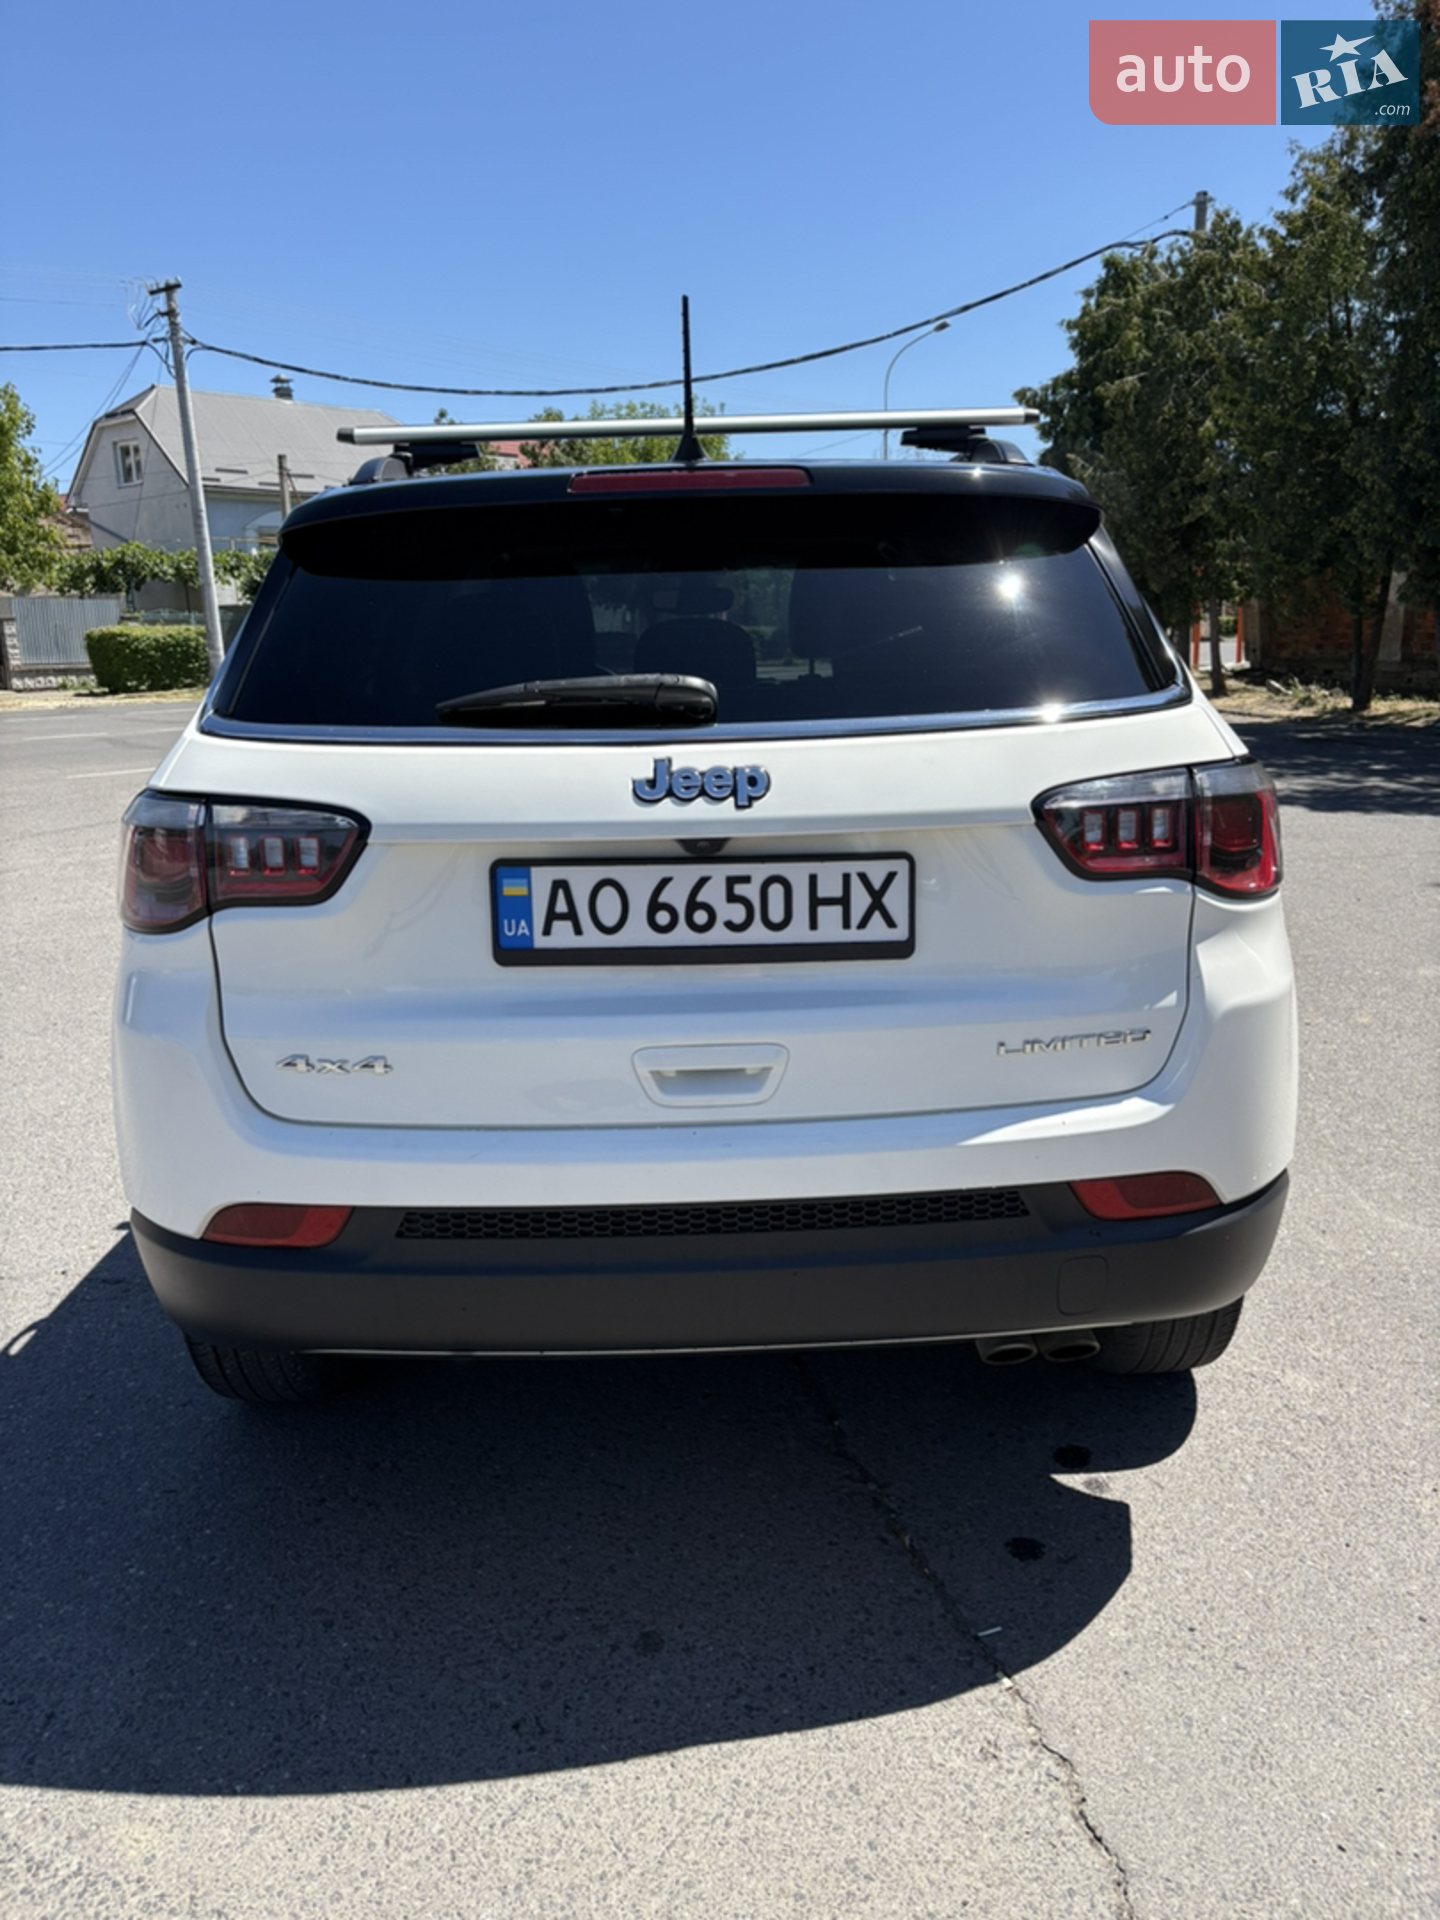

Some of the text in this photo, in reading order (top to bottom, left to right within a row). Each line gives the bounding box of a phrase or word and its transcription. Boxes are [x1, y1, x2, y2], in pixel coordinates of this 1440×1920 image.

[632, 757, 771, 809] Jeep
[542, 871, 898, 936] AO 6650 HX
[503, 919, 530, 936] UA
[997, 1029, 1152, 1055] LIMITED
